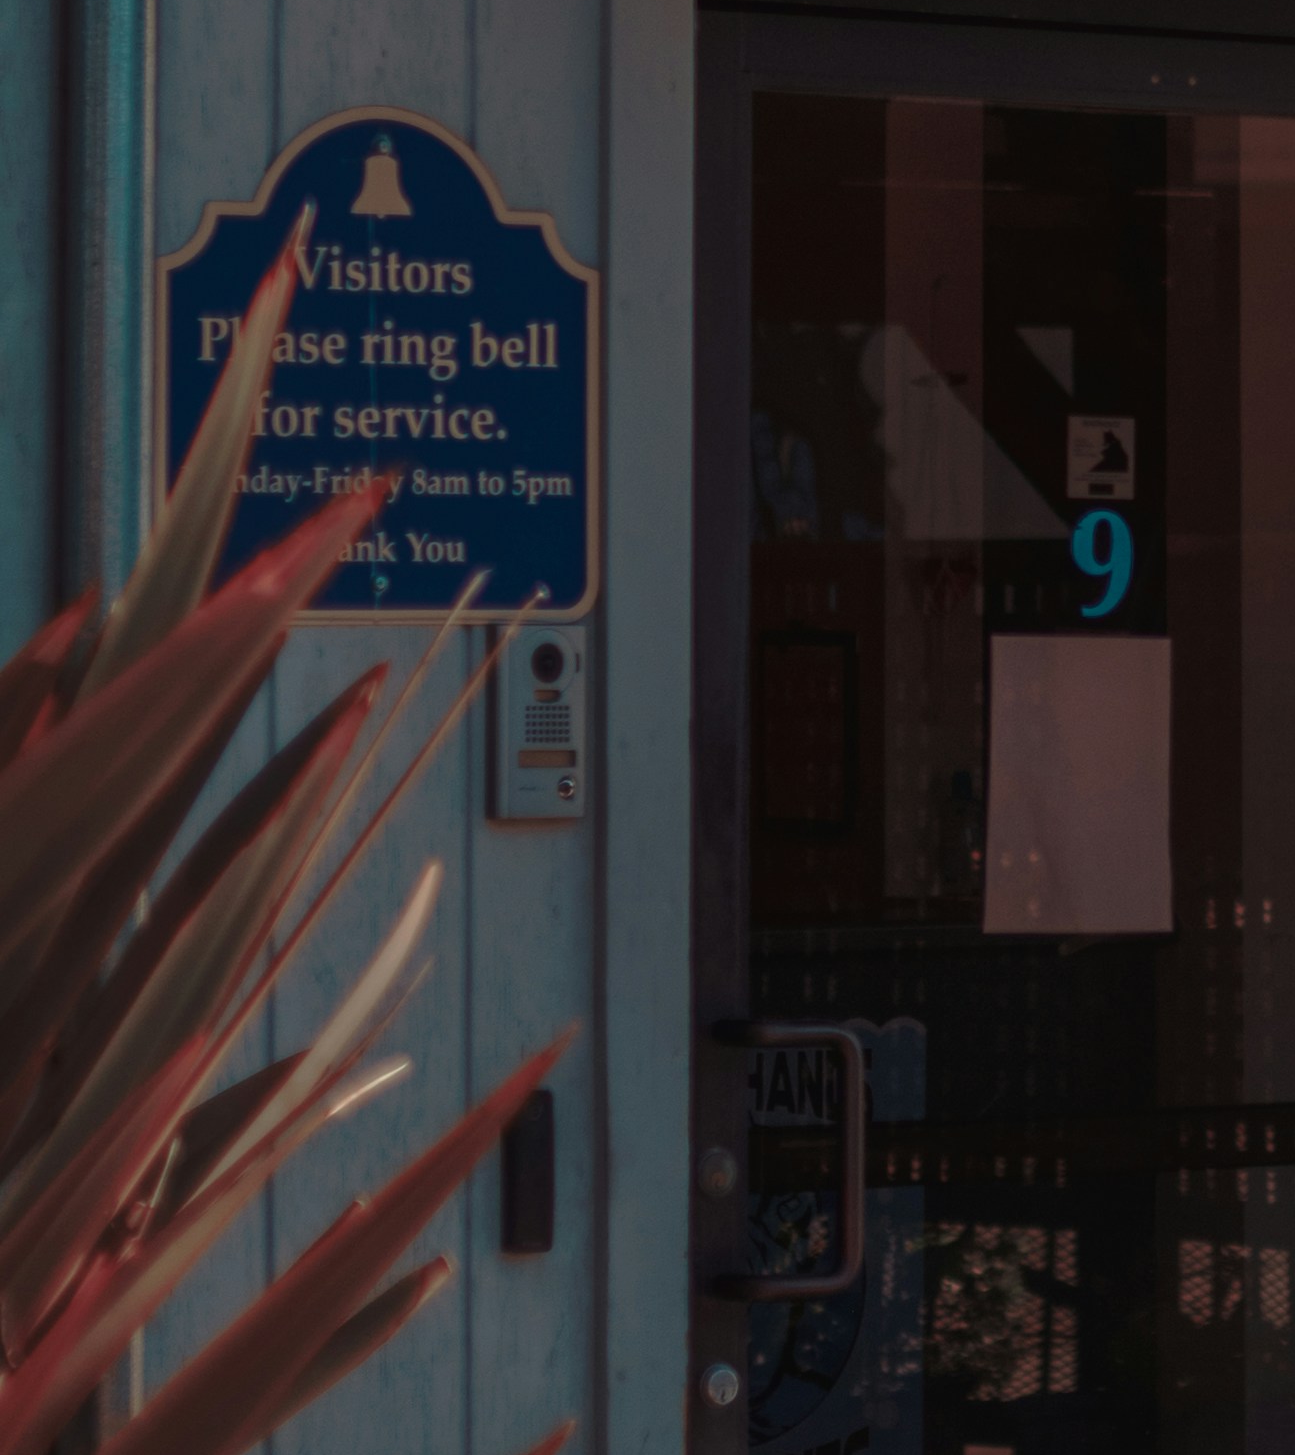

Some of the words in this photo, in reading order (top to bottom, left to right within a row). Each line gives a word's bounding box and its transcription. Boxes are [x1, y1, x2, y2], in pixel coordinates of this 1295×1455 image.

[297, 245, 474, 295] Visitors
[196, 316, 348, 366] Plase
[359, 320, 458, 381] ring
[470, 321, 559, 369] bell
[251, 389, 323, 438] for
[333, 393, 509, 441] service.
[411, 467, 471, 496] 8am
[477, 470, 506, 496] to
[511, 469, 574, 506] 5pm
[338, 531, 397, 563] ank
[405, 532, 466, 563] You
[1070, 509, 1135, 619] 9
